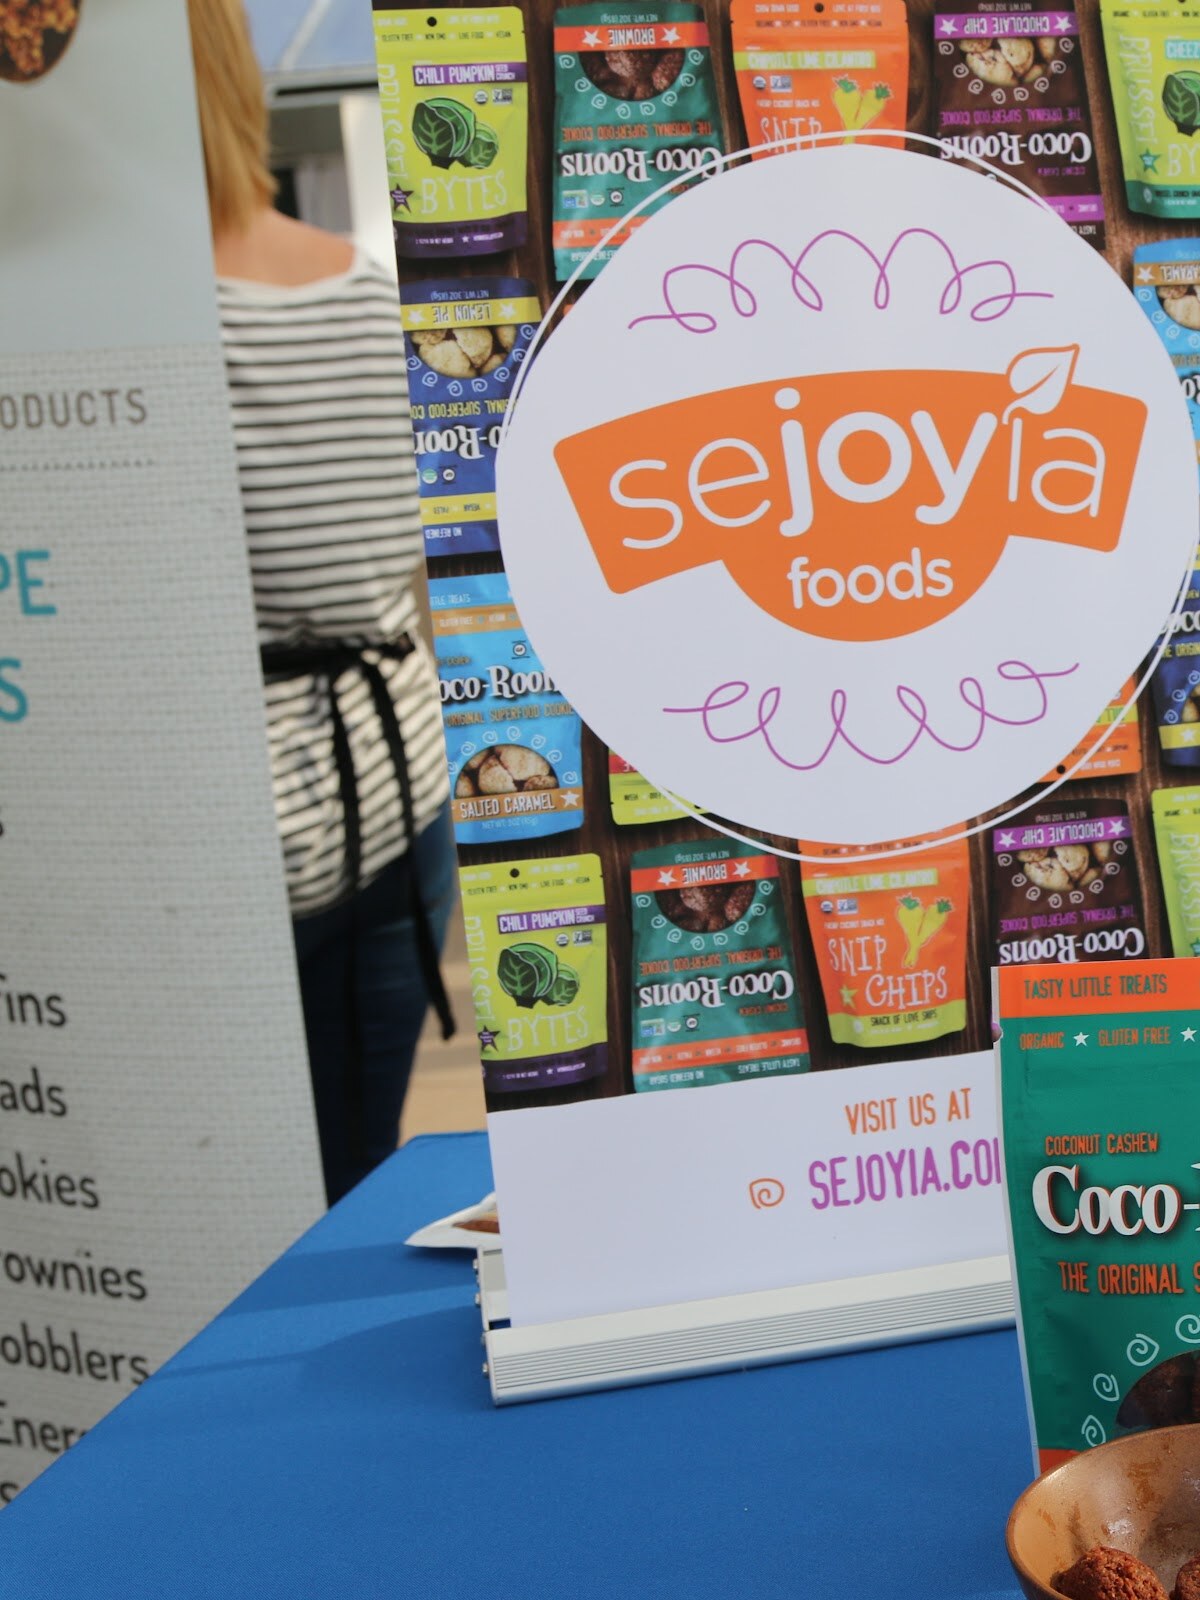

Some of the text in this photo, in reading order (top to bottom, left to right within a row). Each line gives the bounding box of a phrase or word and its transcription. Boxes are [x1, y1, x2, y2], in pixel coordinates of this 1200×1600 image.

[608, 28, 656, 47] BROWNIE
[964, 16, 1050, 34] CHOCOLATE CHIP
[415, 65, 495, 84] CHILI PUMPKIN
[940, 132, 1092, 165] Coco-Roons
[560, 147, 724, 183] Coco-Roons
[421, 169, 508, 214] BYTES
[431, 302, 492, 324] LEMON PIE
[428, 400, 481, 419] SUPERFOOD
[608, 387, 1106, 550] sejoyia
[786, 546, 954, 609] foods
[489, 704, 542, 723] SUPERFOOD
[459, 792, 556, 819] SALTED CARAMEL
[1022, 822, 1105, 846] CHOCOLATE CHIP
[682, 863, 728, 884] BROWNIE
[500, 908, 575, 933] CHILI PUMPKIN
[828, 934, 887, 976] SNIP
[999, 927, 1145, 965] Coco-Roons
[639, 970, 794, 1008] Coco-Roons
[865, 966, 948, 1010] CHIPS
[1025, 975, 1167, 998] TASTY LITTLE TREATS
[507, 1005, 589, 1052] BYTES
[870, 1012, 892, 1026] SNACK
[893, 1012, 901, 1024] OF
[904, 1010, 920, 1023] LOVE
[1020, 1032, 1064, 1050] ORGANIC
[1099, 1028, 1138, 1046] GLUTEN
[1144, 1027, 1170, 1044] FREE
[845, 1088, 971, 1135] VISIT US AT
[1045, 1132, 1158, 1156] COCONUT CASHEW
[1057, 1261, 1090, 1294] THE
[1097, 1262, 1184, 1295] ORIGINAL
